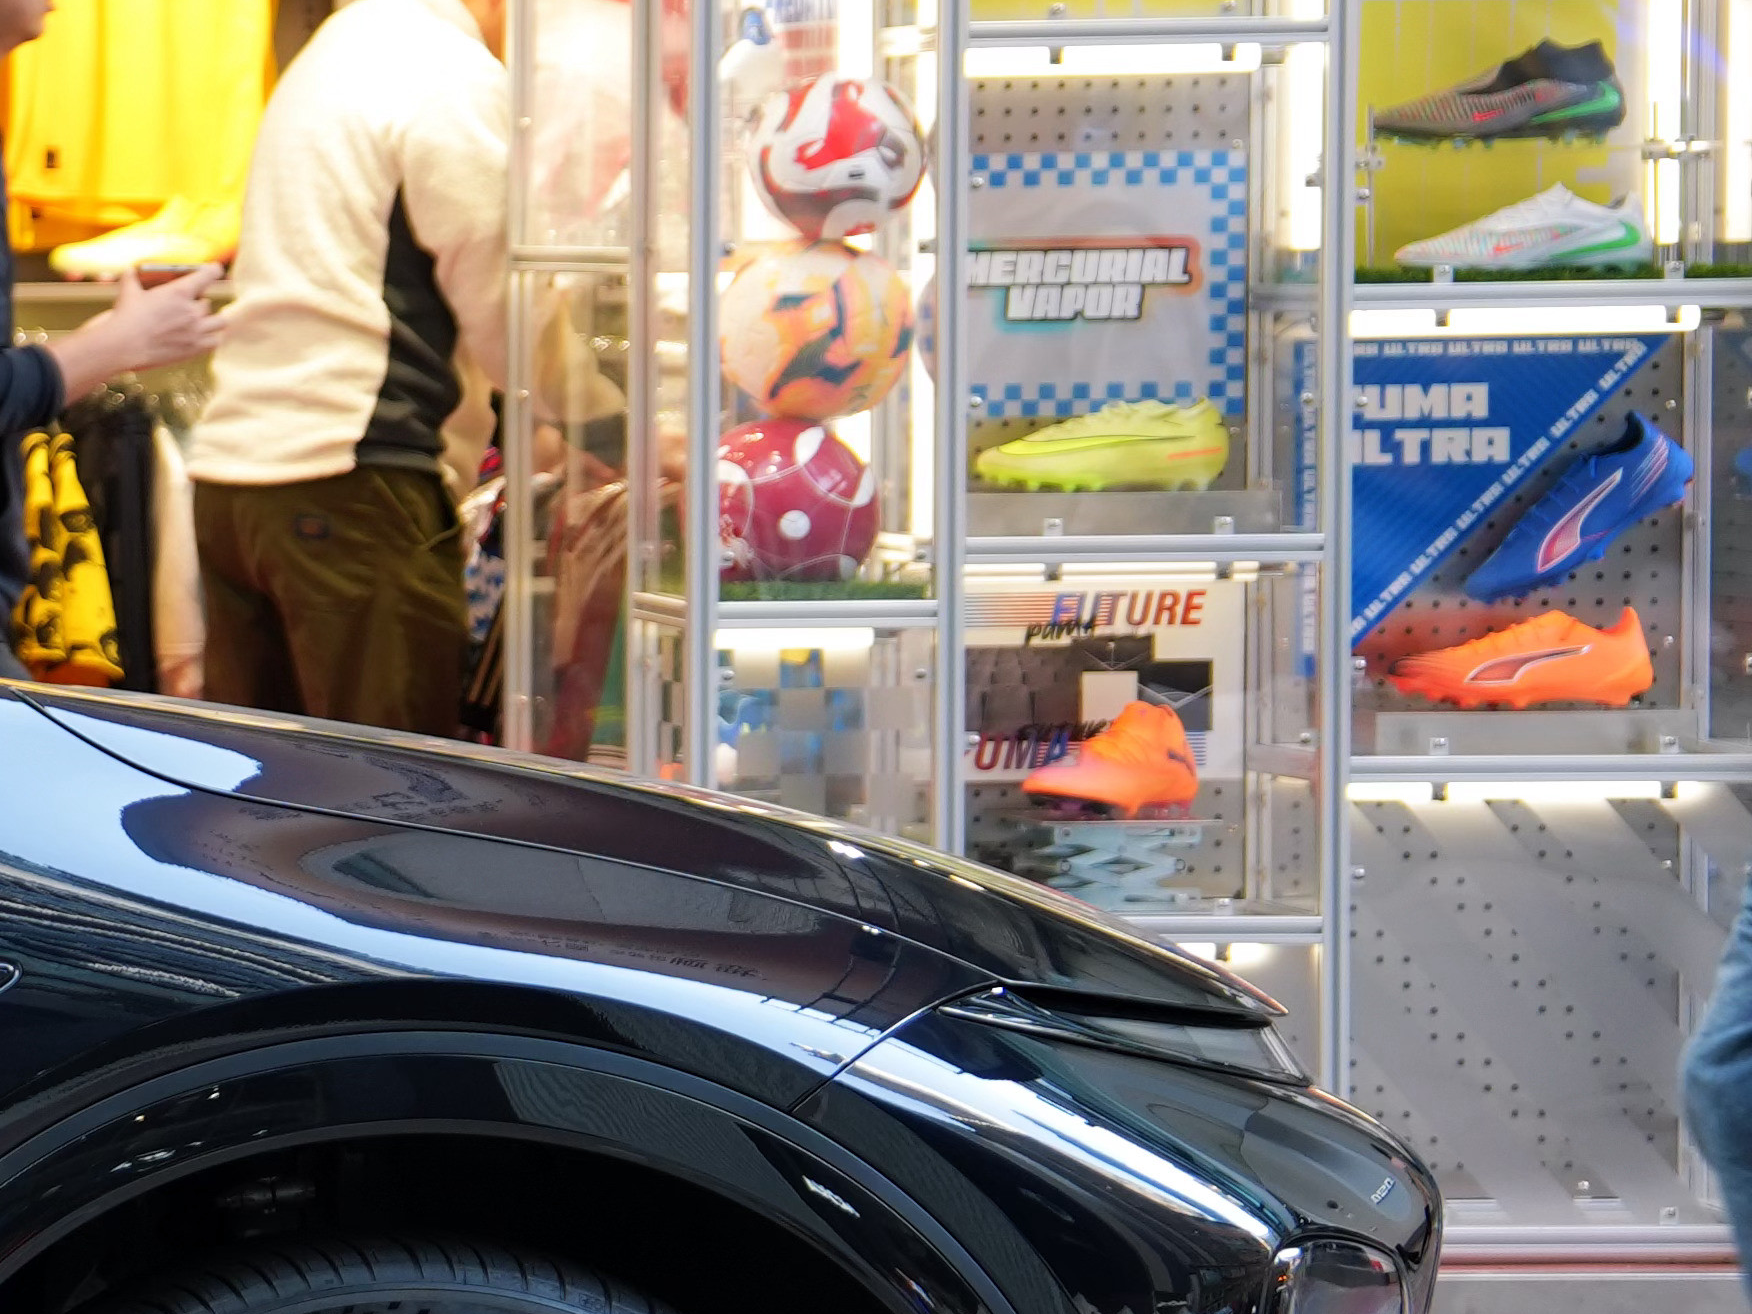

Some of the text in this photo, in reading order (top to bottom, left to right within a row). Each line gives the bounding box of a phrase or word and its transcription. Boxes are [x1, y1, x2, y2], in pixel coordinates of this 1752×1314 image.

[966, 247, 1192, 286] MERCURIAL
[1004, 284, 1143, 322] VAPOR
[1051, 588, 1207, 626] FUTURE
